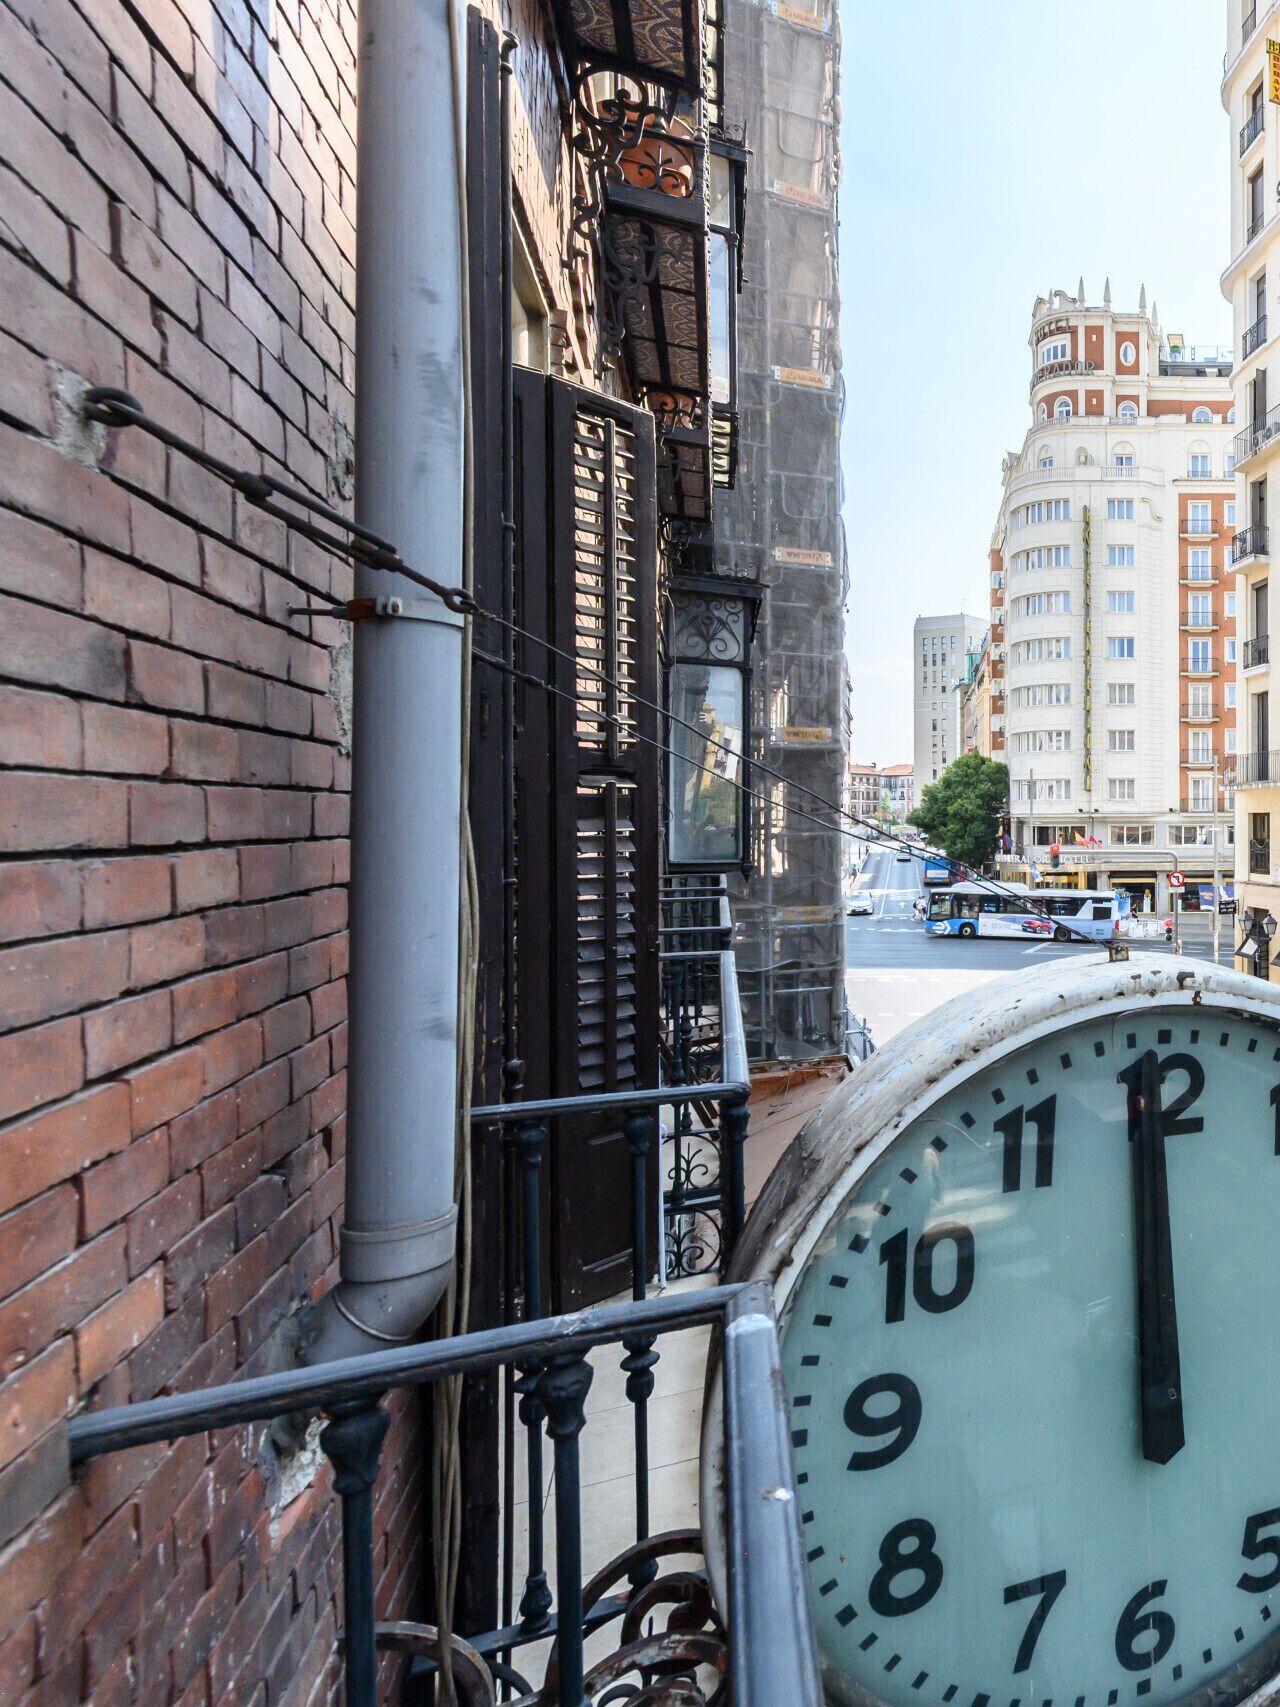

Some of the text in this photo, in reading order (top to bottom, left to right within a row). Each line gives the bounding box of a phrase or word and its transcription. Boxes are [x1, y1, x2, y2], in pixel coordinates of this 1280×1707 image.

[994, 1094, 1058, 1193] 11
[879, 1220, 975, 1324] 10
[842, 1372, 922, 1471] 9
[868, 1518, 944, 1618] 8
[1004, 1569, 1067, 1674] 7
[1115, 1579, 1176, 1672] 6
